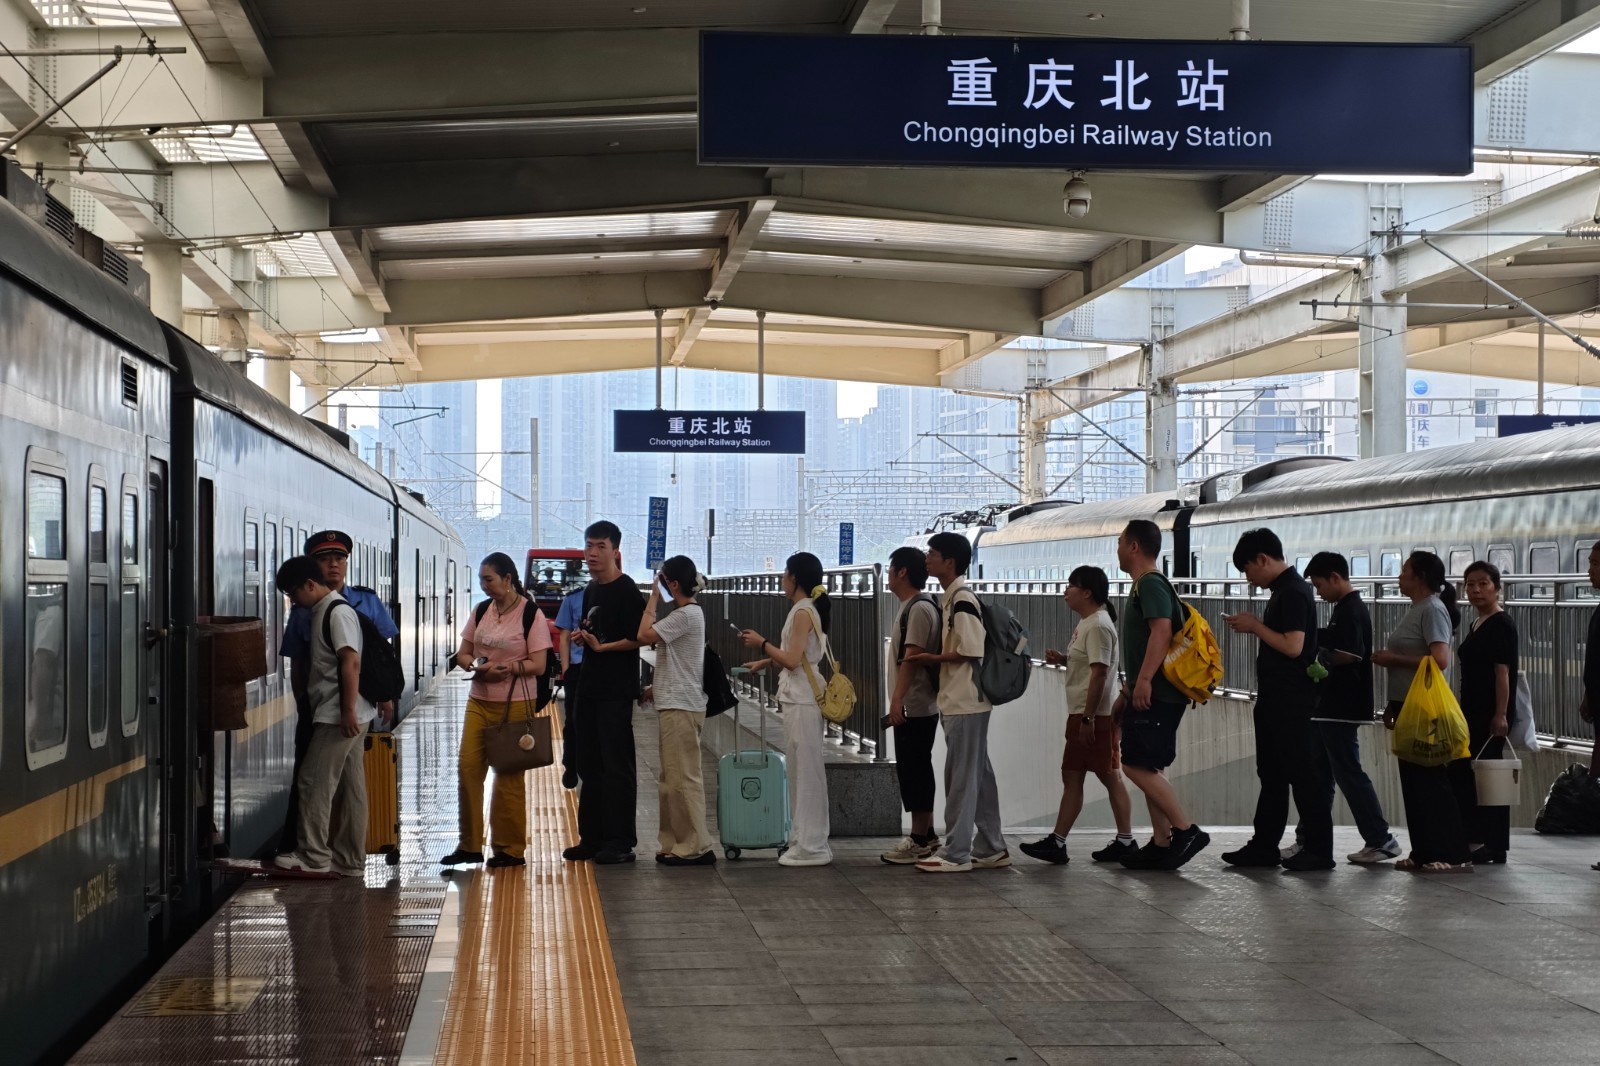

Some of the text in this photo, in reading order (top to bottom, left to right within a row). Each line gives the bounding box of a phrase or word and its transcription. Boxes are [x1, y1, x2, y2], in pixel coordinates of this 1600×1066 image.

[947, 57, 1229, 111] 重庆北站
[903, 120, 1272, 151] Chongqingbei Railway Station
[667, 416, 752, 435] 重庆北站
[649, 437, 771, 448] Chongqingbei Railway Station
